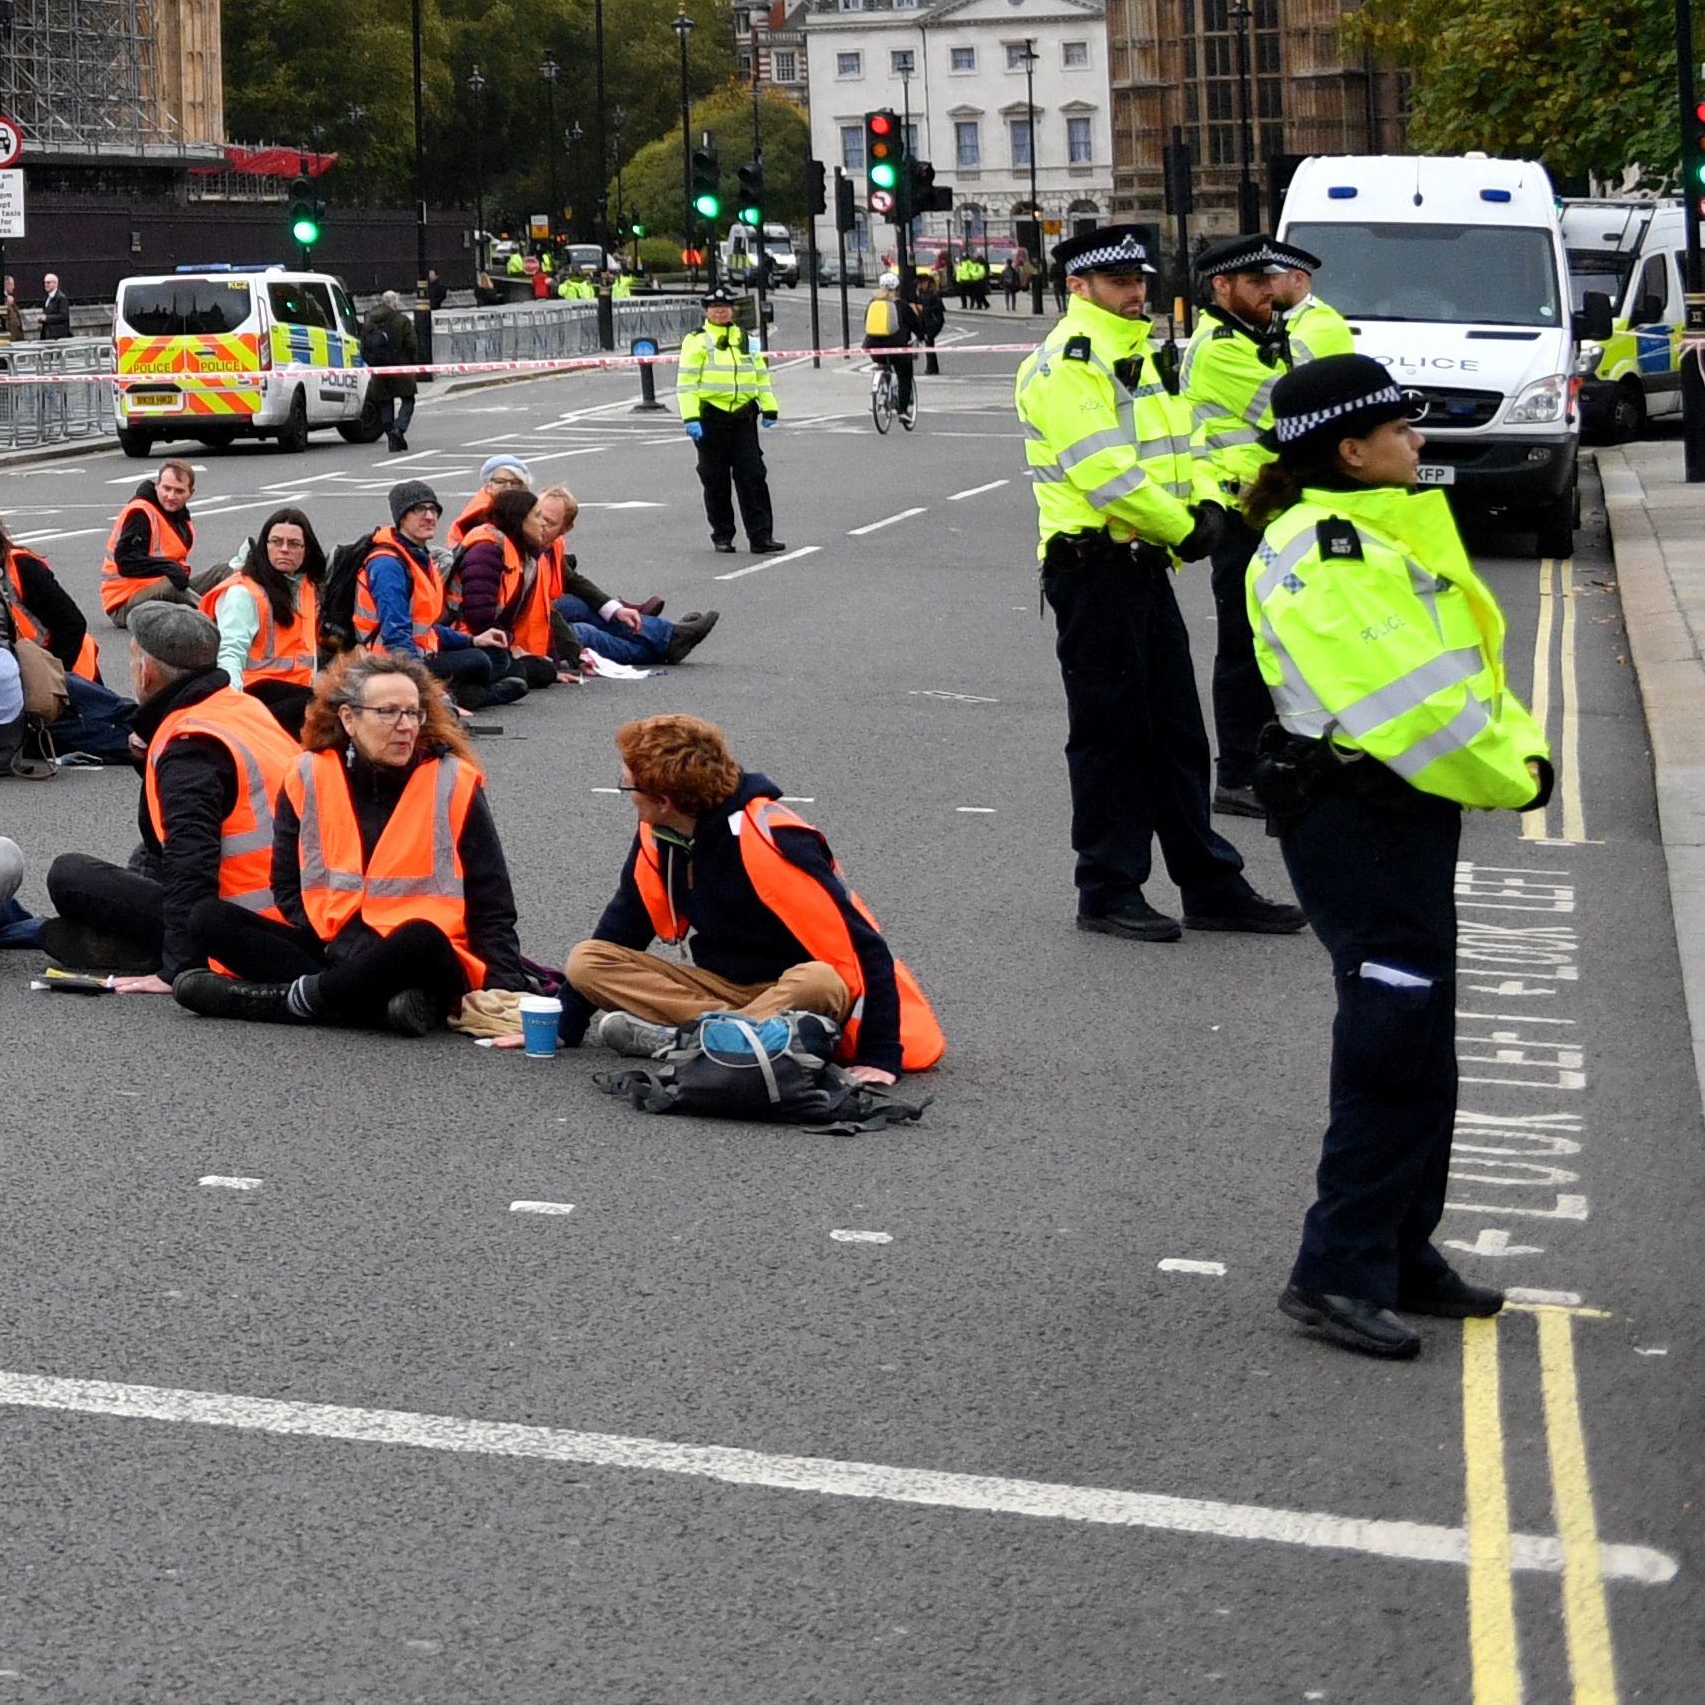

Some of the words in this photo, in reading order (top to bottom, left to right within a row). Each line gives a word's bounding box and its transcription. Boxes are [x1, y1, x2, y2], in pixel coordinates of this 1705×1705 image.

[133, 362, 171, 373] POLICE
[200, 361, 240, 373] POLICE
[1373, 355, 1480, 372] OLICE
